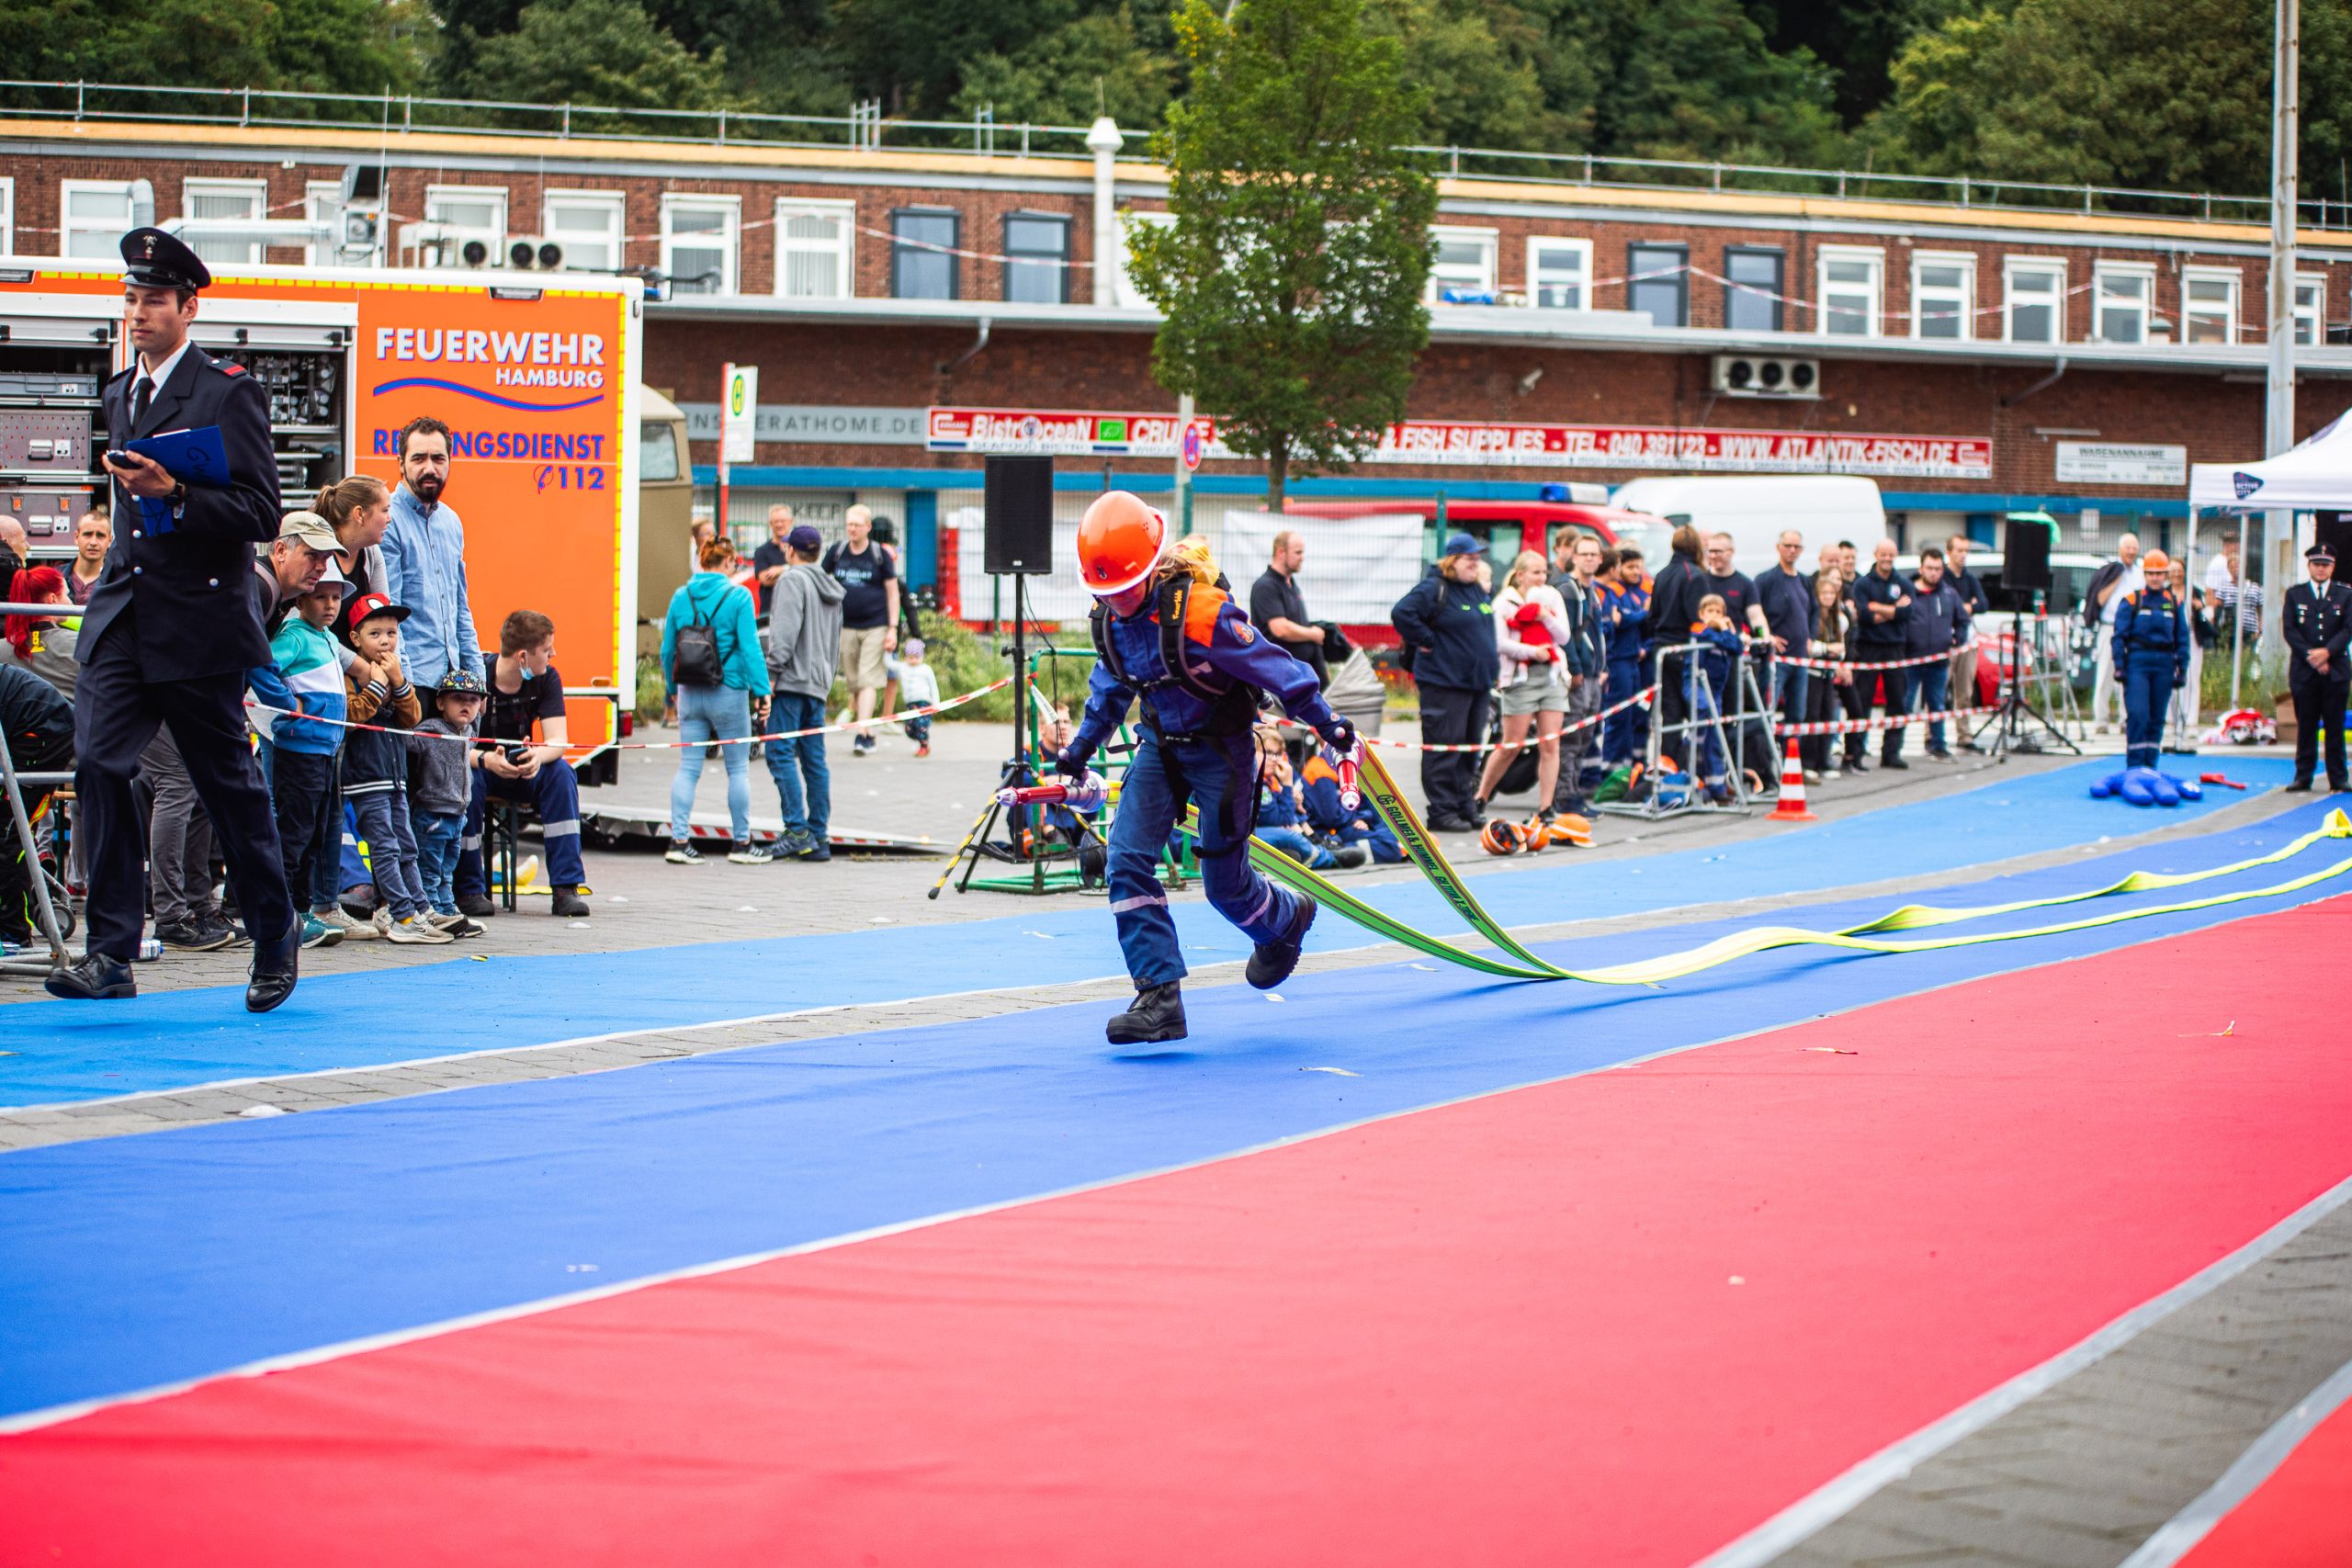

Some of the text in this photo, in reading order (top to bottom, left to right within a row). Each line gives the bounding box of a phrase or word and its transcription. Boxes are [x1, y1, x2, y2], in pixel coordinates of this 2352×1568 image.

[376, 327, 605, 366] FEUERWEHR
[495, 367, 604, 389] HAMBURG
[374, 429, 605, 460] RENGSDIENST
[1398, 427, 1446, 451] FISH
[1447, 429, 1545, 453] SUPPLIES
[1609, 433, 1643, 456] 040
[1720, 436, 1954, 465] WWW.ATLANTIK-FISCH.DE
[558, 466, 605, 490] 112
